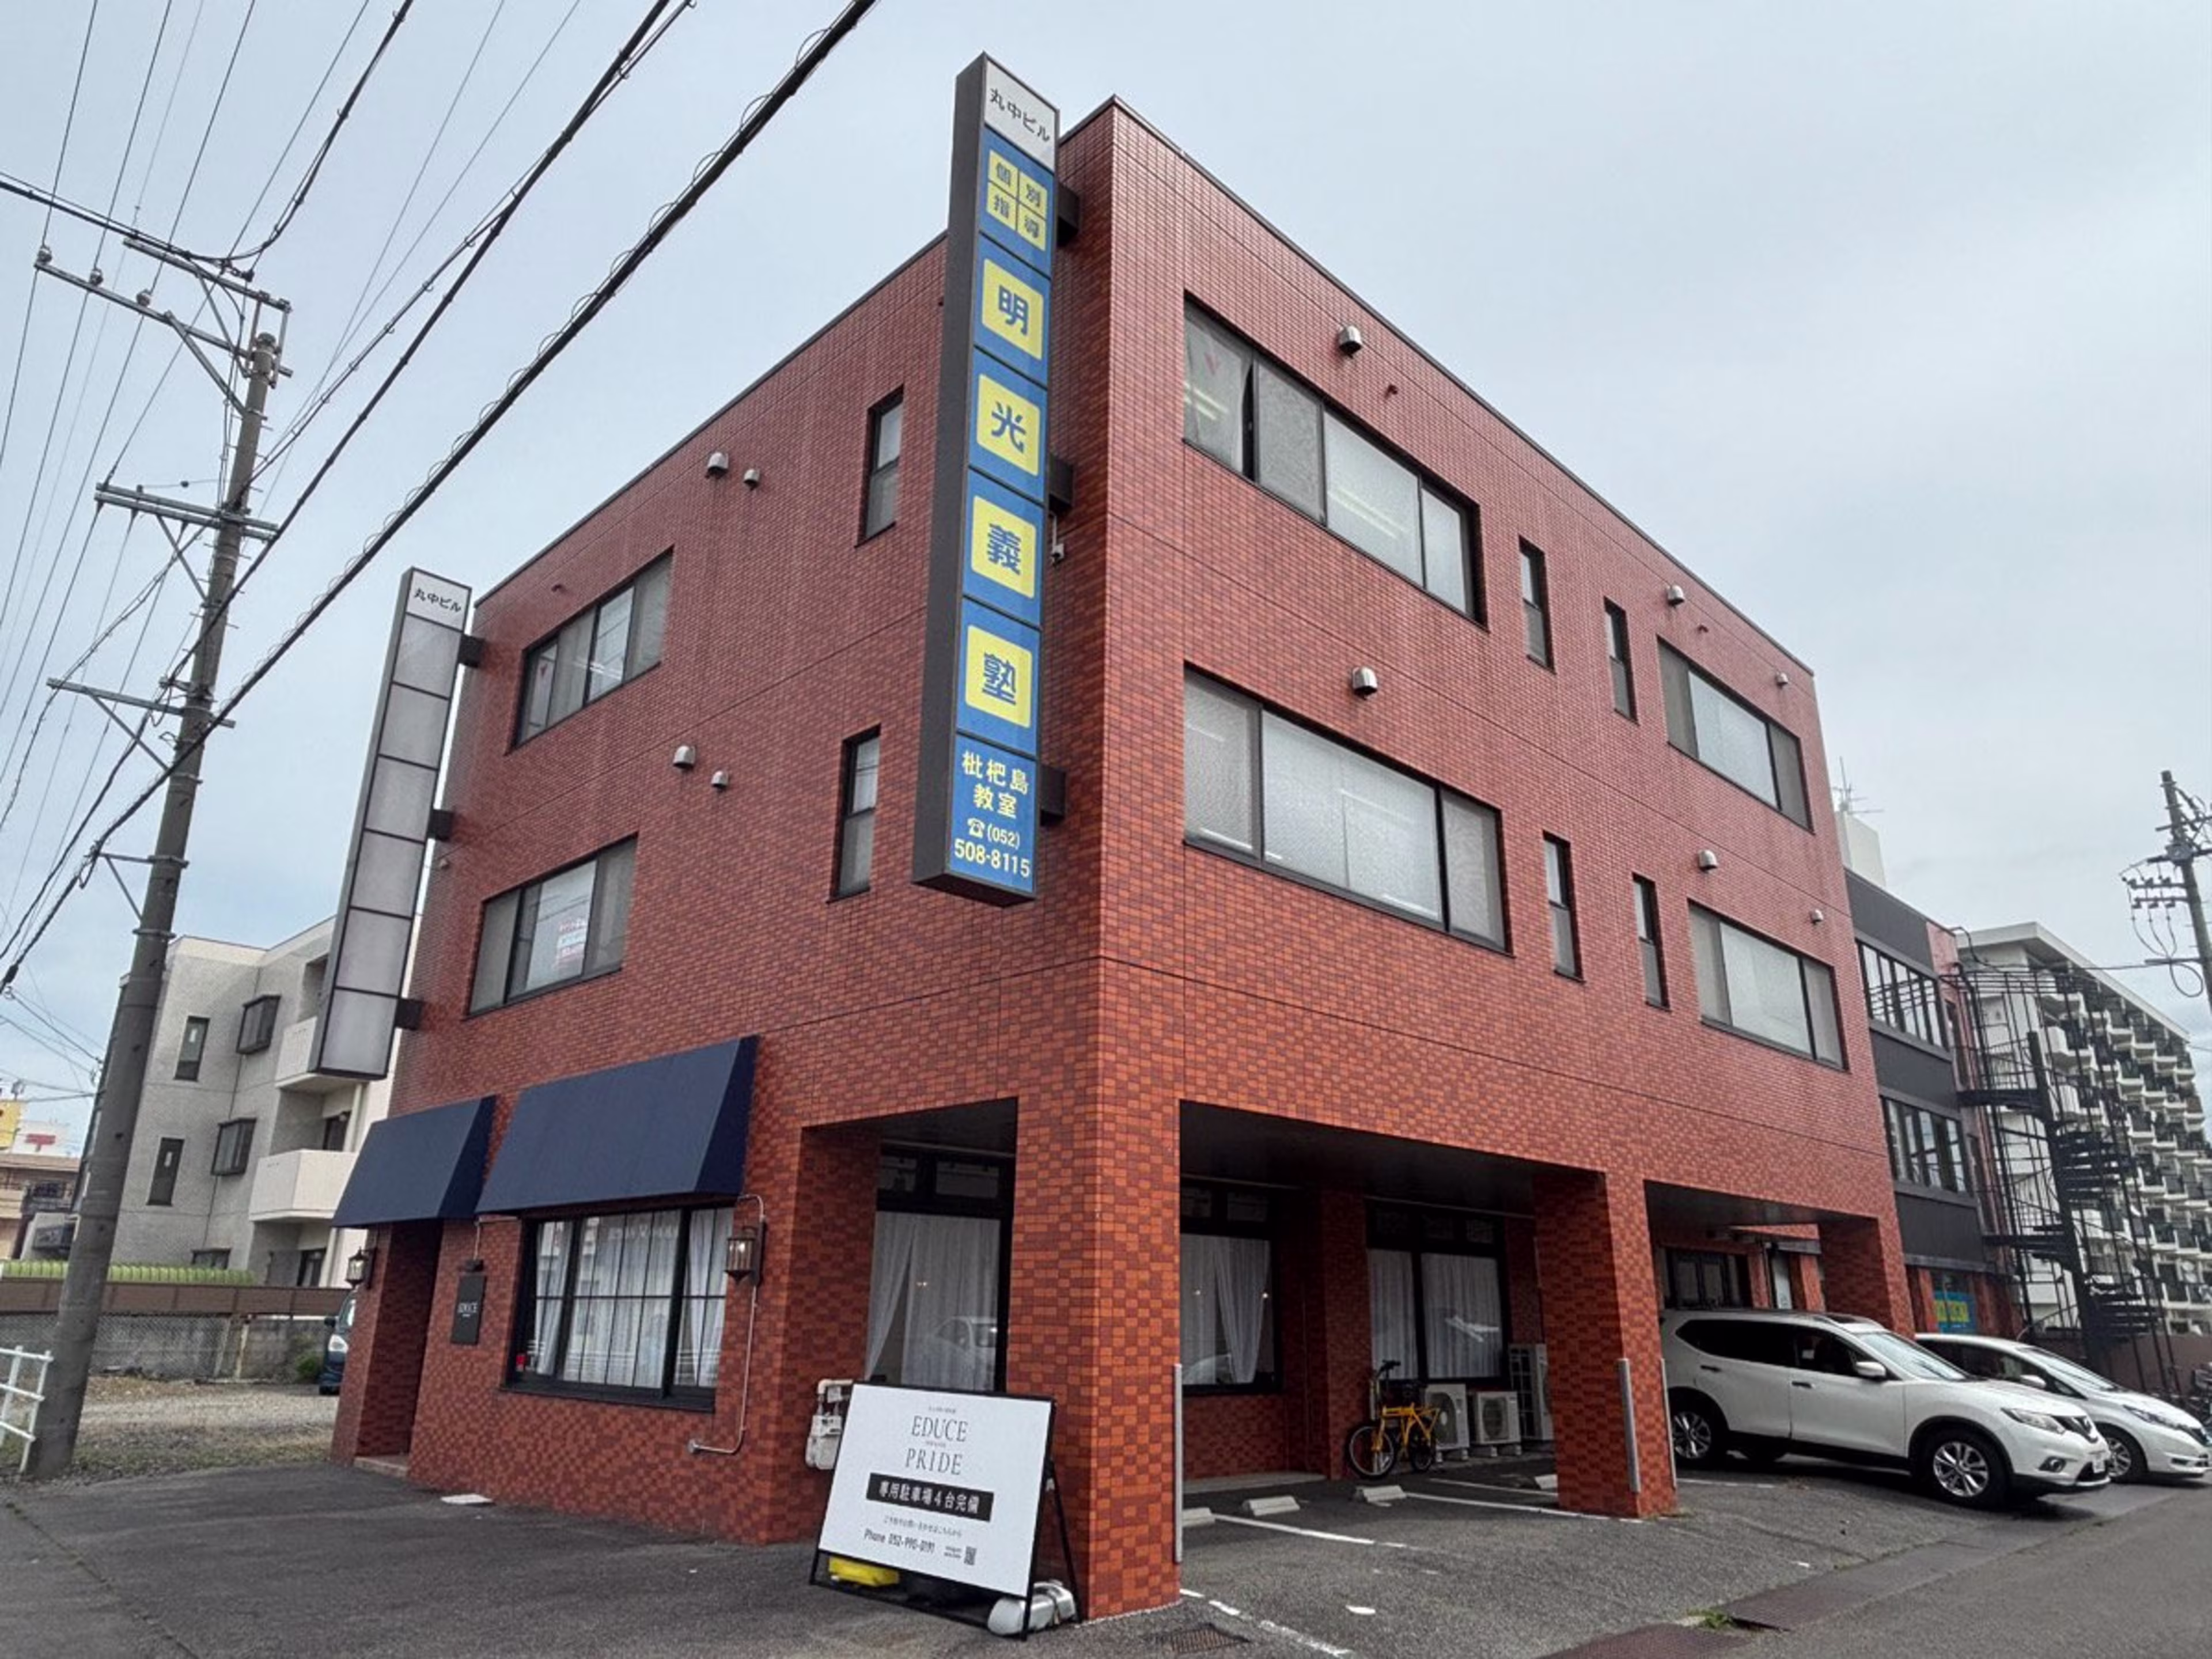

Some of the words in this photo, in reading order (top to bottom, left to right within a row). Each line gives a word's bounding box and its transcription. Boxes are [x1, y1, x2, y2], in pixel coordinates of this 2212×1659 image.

[982, 284, 1029, 706] 明光義塾
[961, 750, 1029, 795] 枇杷島
[973, 783, 1017, 819] 教室
[987, 823, 1021, 850] (052)
[954, 837, 1031, 878] 508-8115
[911, 1415, 969, 1442] EDUCE
[905, 1448, 963, 1476] PRIDE
